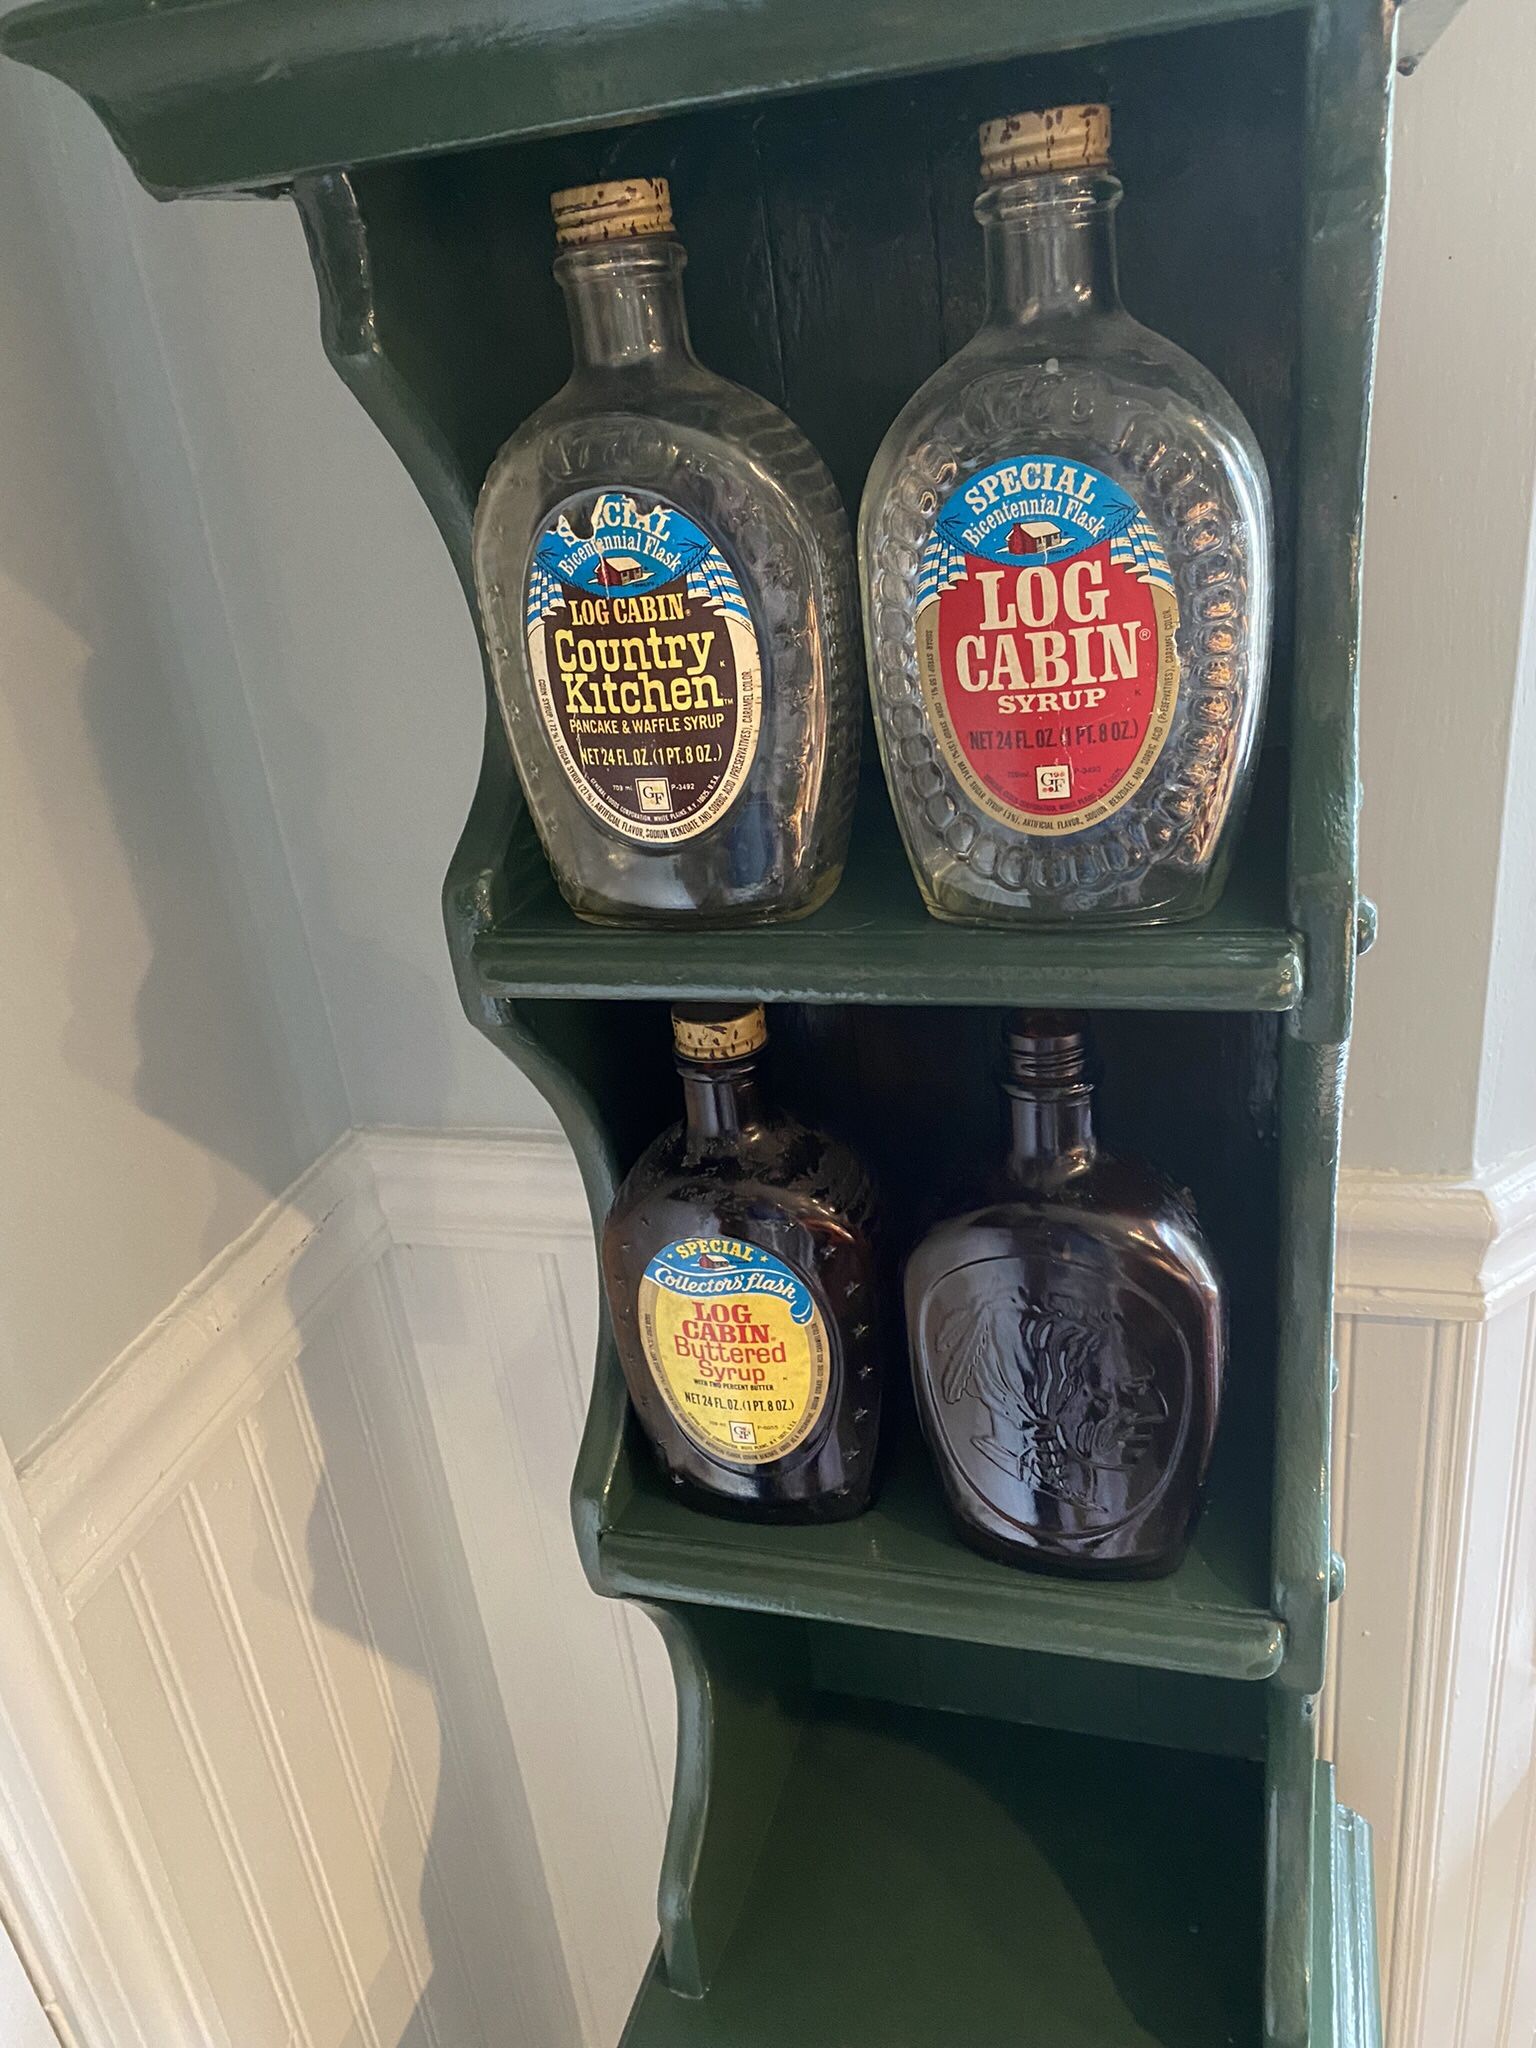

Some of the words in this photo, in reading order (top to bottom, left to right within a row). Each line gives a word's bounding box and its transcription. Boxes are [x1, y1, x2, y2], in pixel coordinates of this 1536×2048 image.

[965, 463, 1097, 515] SPECIAL
[556, 500, 671, 548] SCIAL
[961, 493, 1062, 548] Bicentennial
[1062, 498, 1105, 538] Flask
[643, 535, 681, 572] Flask
[975, 560, 1110, 630] LOG
[568, 598, 609, 626] LOG
[554, 627, 714, 675] Country
[561, 672, 724, 714] Kitchen
[998, 688, 1106, 715] SYRUP
[569, 719, 619, 734] PANCAKE
[621, 719, 631, 734] &
[632, 717, 681, 734] WAFFLE
[684, 713, 725, 731] SYRUP
[969, 731, 996, 750] NET
[997, 731, 1014, 750] 24
[1075, 725, 1096, 746] PT.
[1099, 723, 1107, 743] 8
[1111, 719, 1139, 741] OZ.)
[557, 745, 571, 766] SUGAR
[567, 765, 582, 784] SYRUP
[594, 802, 621, 828] ARTIFICIAL
[621, 821, 645, 839] FLAVOR,
[645, 828, 670, 839] SODIUM
[670, 818, 700, 837] BENZOATE
[699, 810, 713, 825] AND
[708, 793, 728, 815] SORBIC
[724, 778, 736, 796] ACID
[742, 693, 753, 725] CARAMEL
[580, 747, 602, 766] NET
[602, 748, 615, 766] 24
[617, 748, 633, 766] FL.
[633, 748, 653, 766] OZ.
[652, 748, 665, 766] (1
[667, 746, 685, 765] PT.
[686, 746, 693, 763] 8
[695, 744, 723, 763] OZ.)
[1108, 780, 1135, 808] BENZOATE
[1132, 766, 1145, 783] AND
[1140, 743, 1156, 770] SORBIC
[1151, 725, 1164, 743] ACID
[675, 1238, 754, 1262] SPECIAL
[692, 1302, 752, 1323] LOG
[674, 1334, 786, 1364] Buttered
[698, 1359, 765, 1384] Syrup
[685, 1392, 701, 1405] NET
[702, 1395, 713, 1408] 24
[727, 1399, 742, 1411] OZ.
[742, 1400, 751, 1411] (1
[752, 1400, 767, 1412] PT.
[767, 1400, 774, 1411] 8
[775, 1400, 794, 1411] OZ.)
